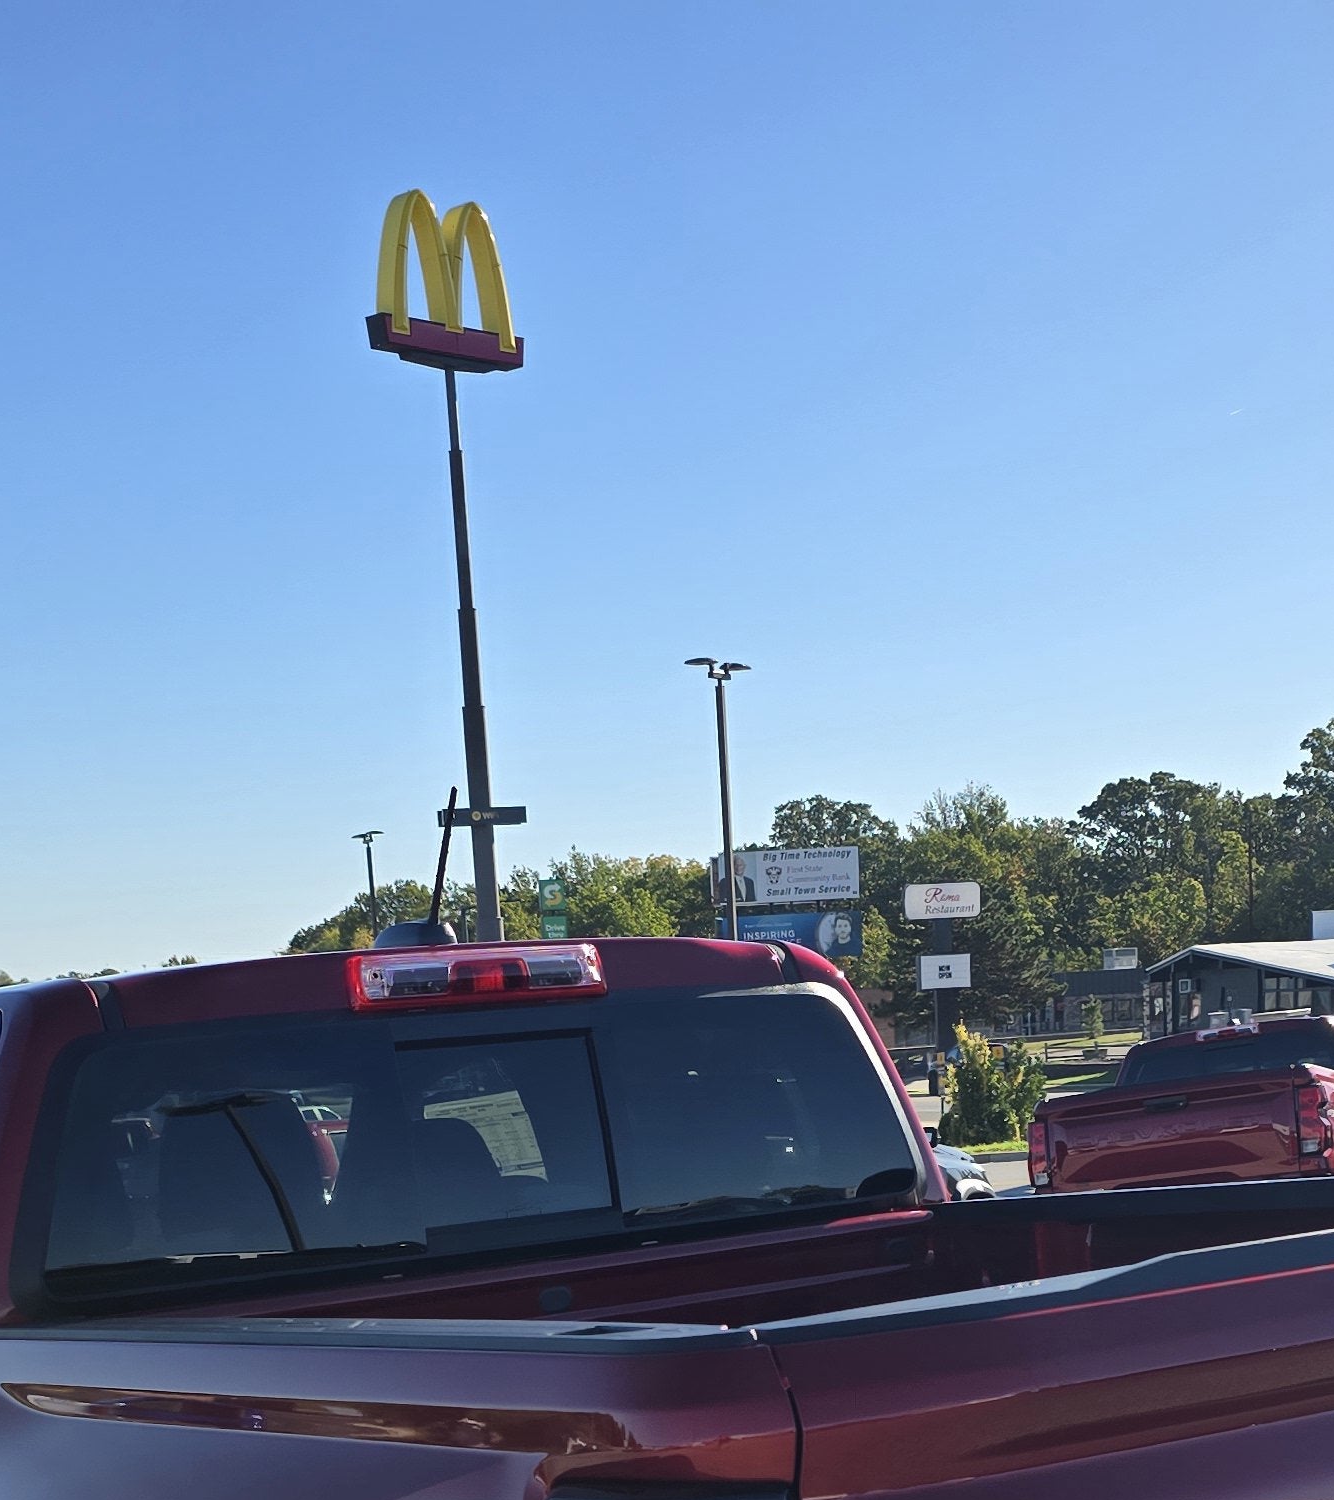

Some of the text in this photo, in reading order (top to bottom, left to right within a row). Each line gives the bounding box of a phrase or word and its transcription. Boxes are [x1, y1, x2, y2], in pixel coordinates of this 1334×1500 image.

[763, 849, 852, 863] Big Time Technology
[787, 864, 823, 874] First State
[787, 873, 850, 884] Community Bank
[767, 888, 791, 897] Small
[794, 886, 815, 896] Town
[818, 885, 851, 894] Service
[925, 887, 960, 904] Roma
[925, 904, 975, 915] Restaurant
[546, 924, 565, 932] Drive
[743, 929, 796, 941] INSPIRING
